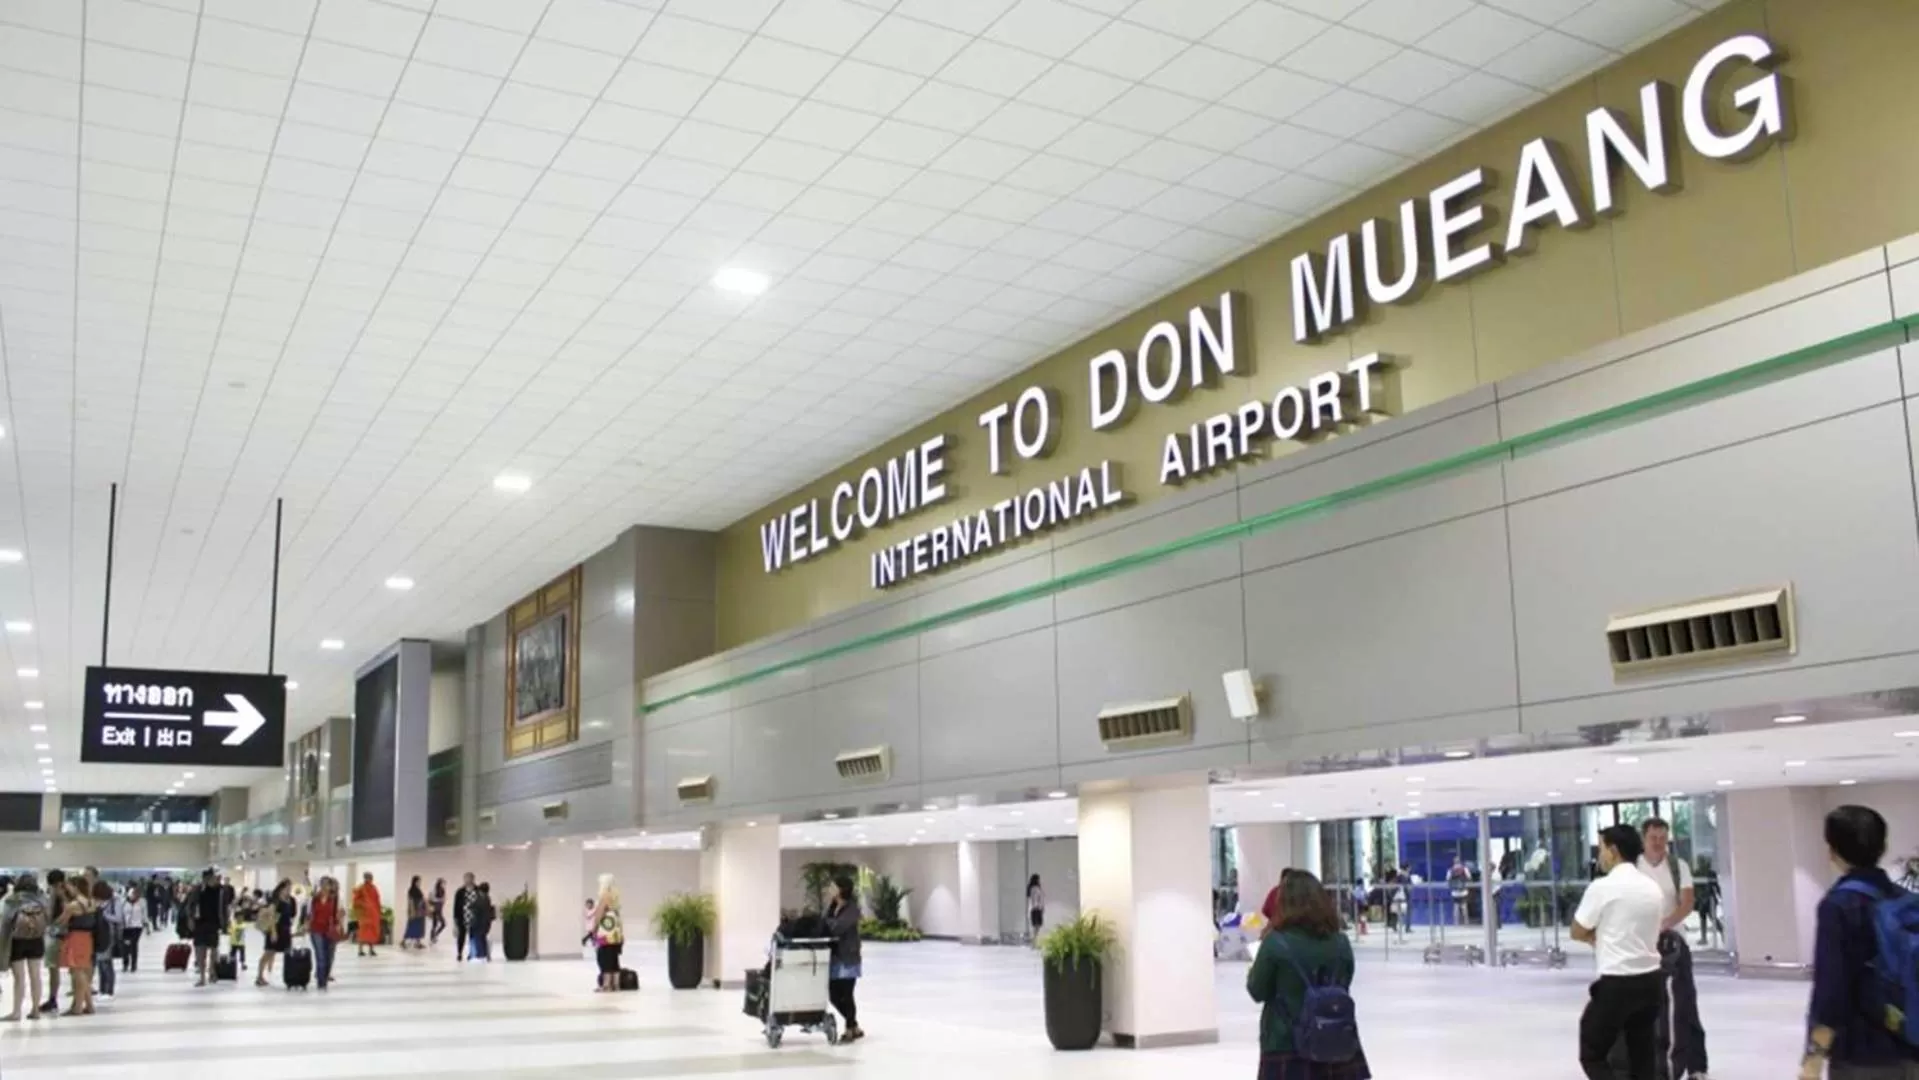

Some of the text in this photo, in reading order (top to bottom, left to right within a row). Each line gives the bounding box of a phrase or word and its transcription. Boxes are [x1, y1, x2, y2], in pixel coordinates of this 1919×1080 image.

[760, 34, 1783, 573] WELCOME TO DON MUEANG
[870, 353, 1380, 588] INTERNATIONAL AIRPORT
[102, 726, 193, 747] Exit 出口
[103, 682, 193, 707] ทางออก
